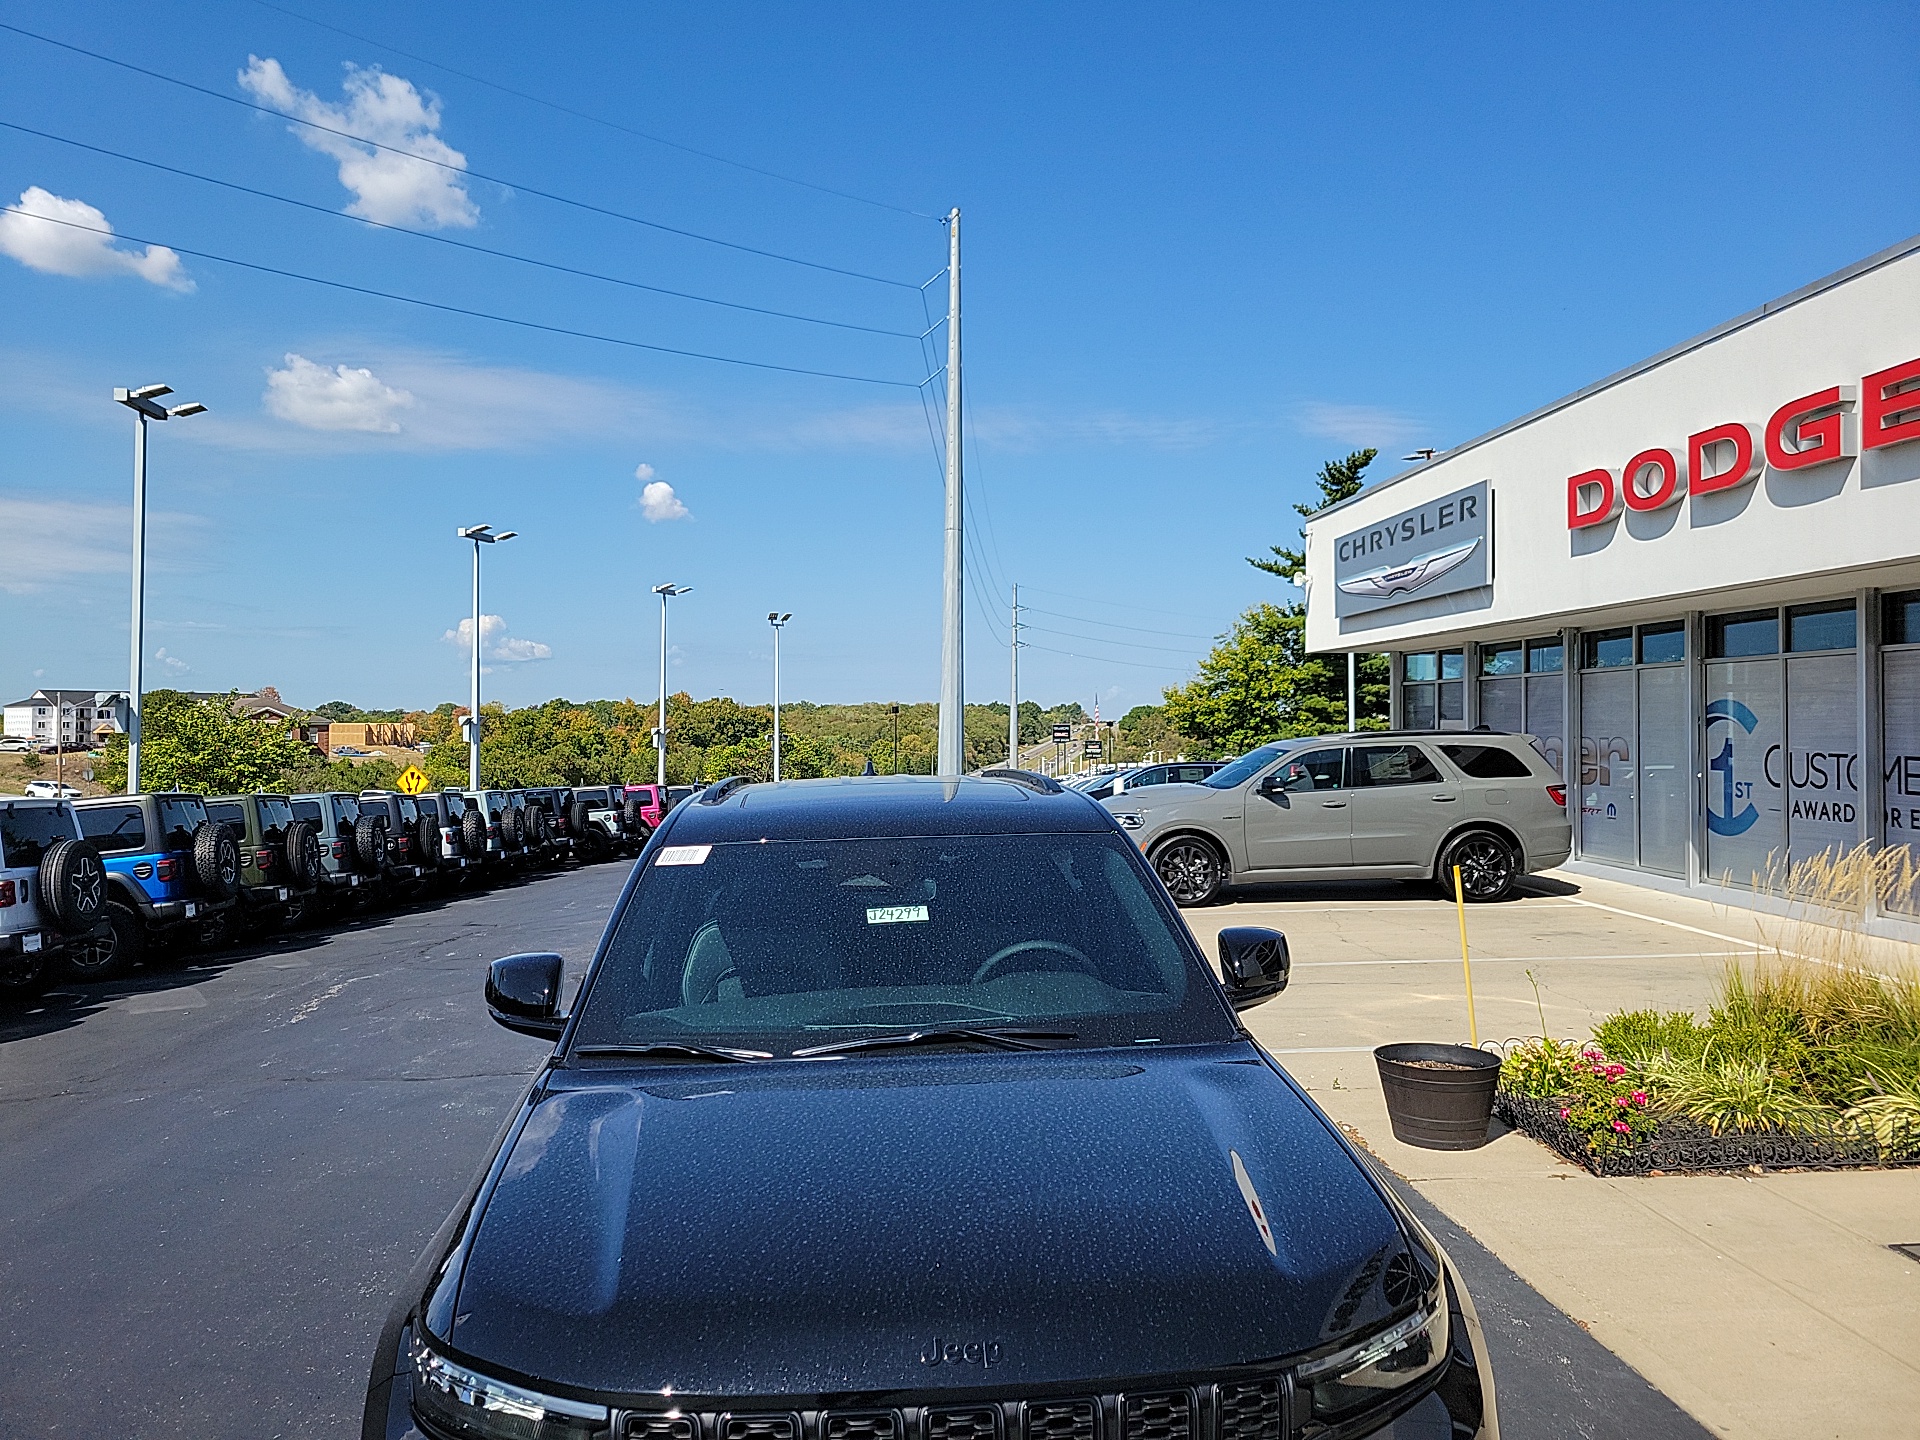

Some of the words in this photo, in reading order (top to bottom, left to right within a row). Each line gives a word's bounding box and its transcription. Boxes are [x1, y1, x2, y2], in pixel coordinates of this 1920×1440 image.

[1567, 357, 1920, 530] DODGE
[1339, 495, 1477, 562] CHRYSLER
[1791, 800, 1855, 823] AWARD
[920, 1336, 1003, 1369] Jeep
